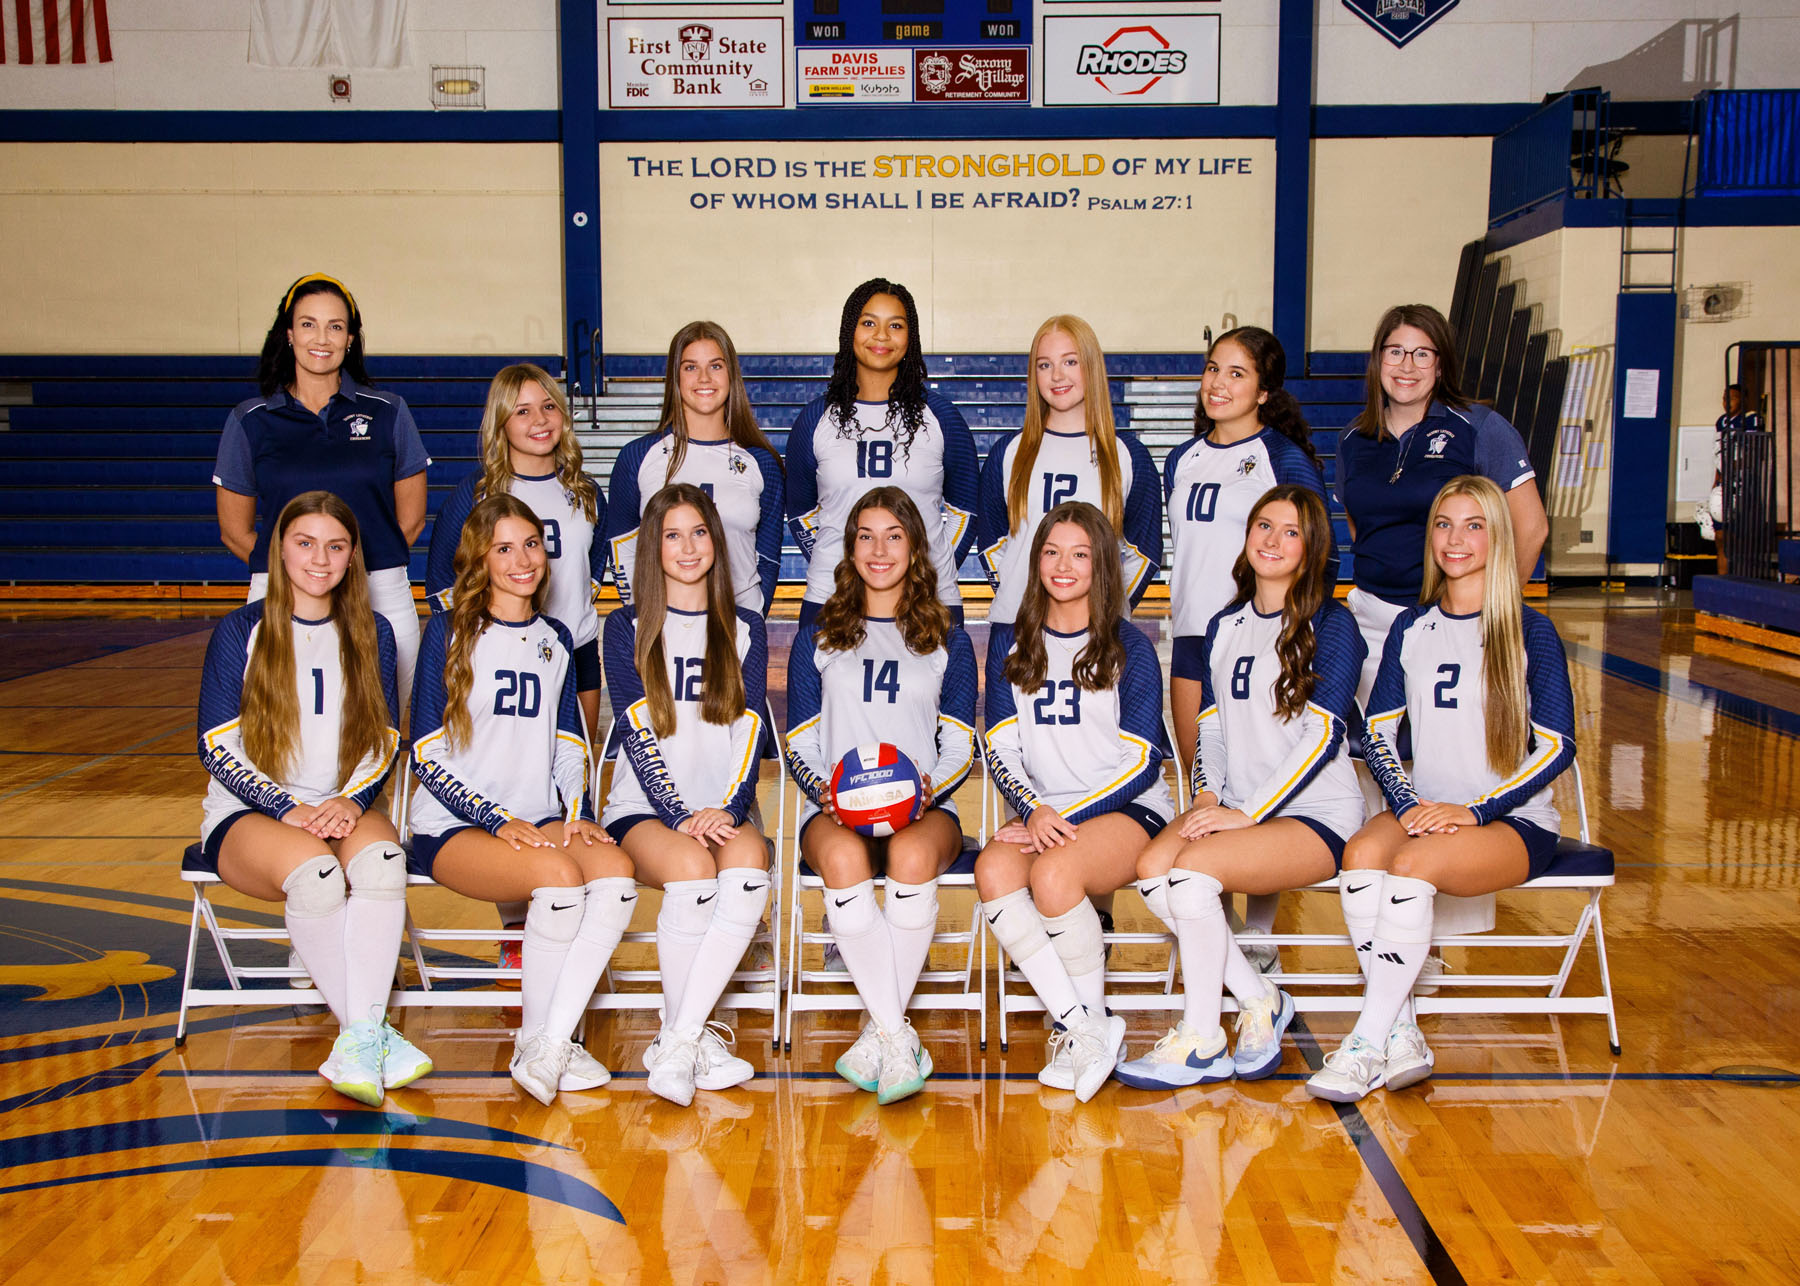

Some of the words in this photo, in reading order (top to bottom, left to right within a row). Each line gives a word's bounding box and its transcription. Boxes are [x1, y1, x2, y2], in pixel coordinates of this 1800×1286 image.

[813, 25, 839, 37] won
[896, 25, 930, 40] game
[988, 24, 1014, 36] won
[628, 37, 671, 54] First
[719, 36, 767, 54] State
[641, 59, 753, 79] Community
[832, 53, 878, 65] DAVIS
[955, 54, 1012, 84] Saxony
[1077, 45, 1187, 75] RHODES
[804, 66, 839, 76] FARM
[843, 66, 905, 76] SUPPLIES
[975, 69, 1025, 92] Village
[626, 87, 650, 97] FDIC
[672, 78, 722, 95] Bank
[861, 84, 900, 93] Kubota
[691, 157, 776, 178] LORD
[785, 160, 808, 178] IS
[814, 160, 866, 178] THE
[873, 153, 1105, 178] STRONGHOLD
[1112, 158, 1147, 175] OF
[1155, 158, 1191, 175] MY
[1198, 158, 1252, 175] LIFE
[690, 193, 725, 209] OF
[732, 193, 817, 209] WHOM
[825, 193, 908, 209] SHALL
[916, 190, 922, 209] I
[931, 192, 964, 209] BE
[972, 188, 1080, 209] AFRAID?
[1152, 195, 1193, 210] 27:1
[857, 441, 893, 478] 18
[1186, 483, 1221, 522] 10
[674, 656, 705, 701] 12
[863, 659, 900, 703] 14
[1231, 656, 1255, 699] 8
[1434, 663, 1461, 709] 2
[312, 668, 324, 715] 1
[493, 669, 541, 718] 20
[1033, 680, 1081, 725] 23
[850, 769, 894, 785] VFC1000
